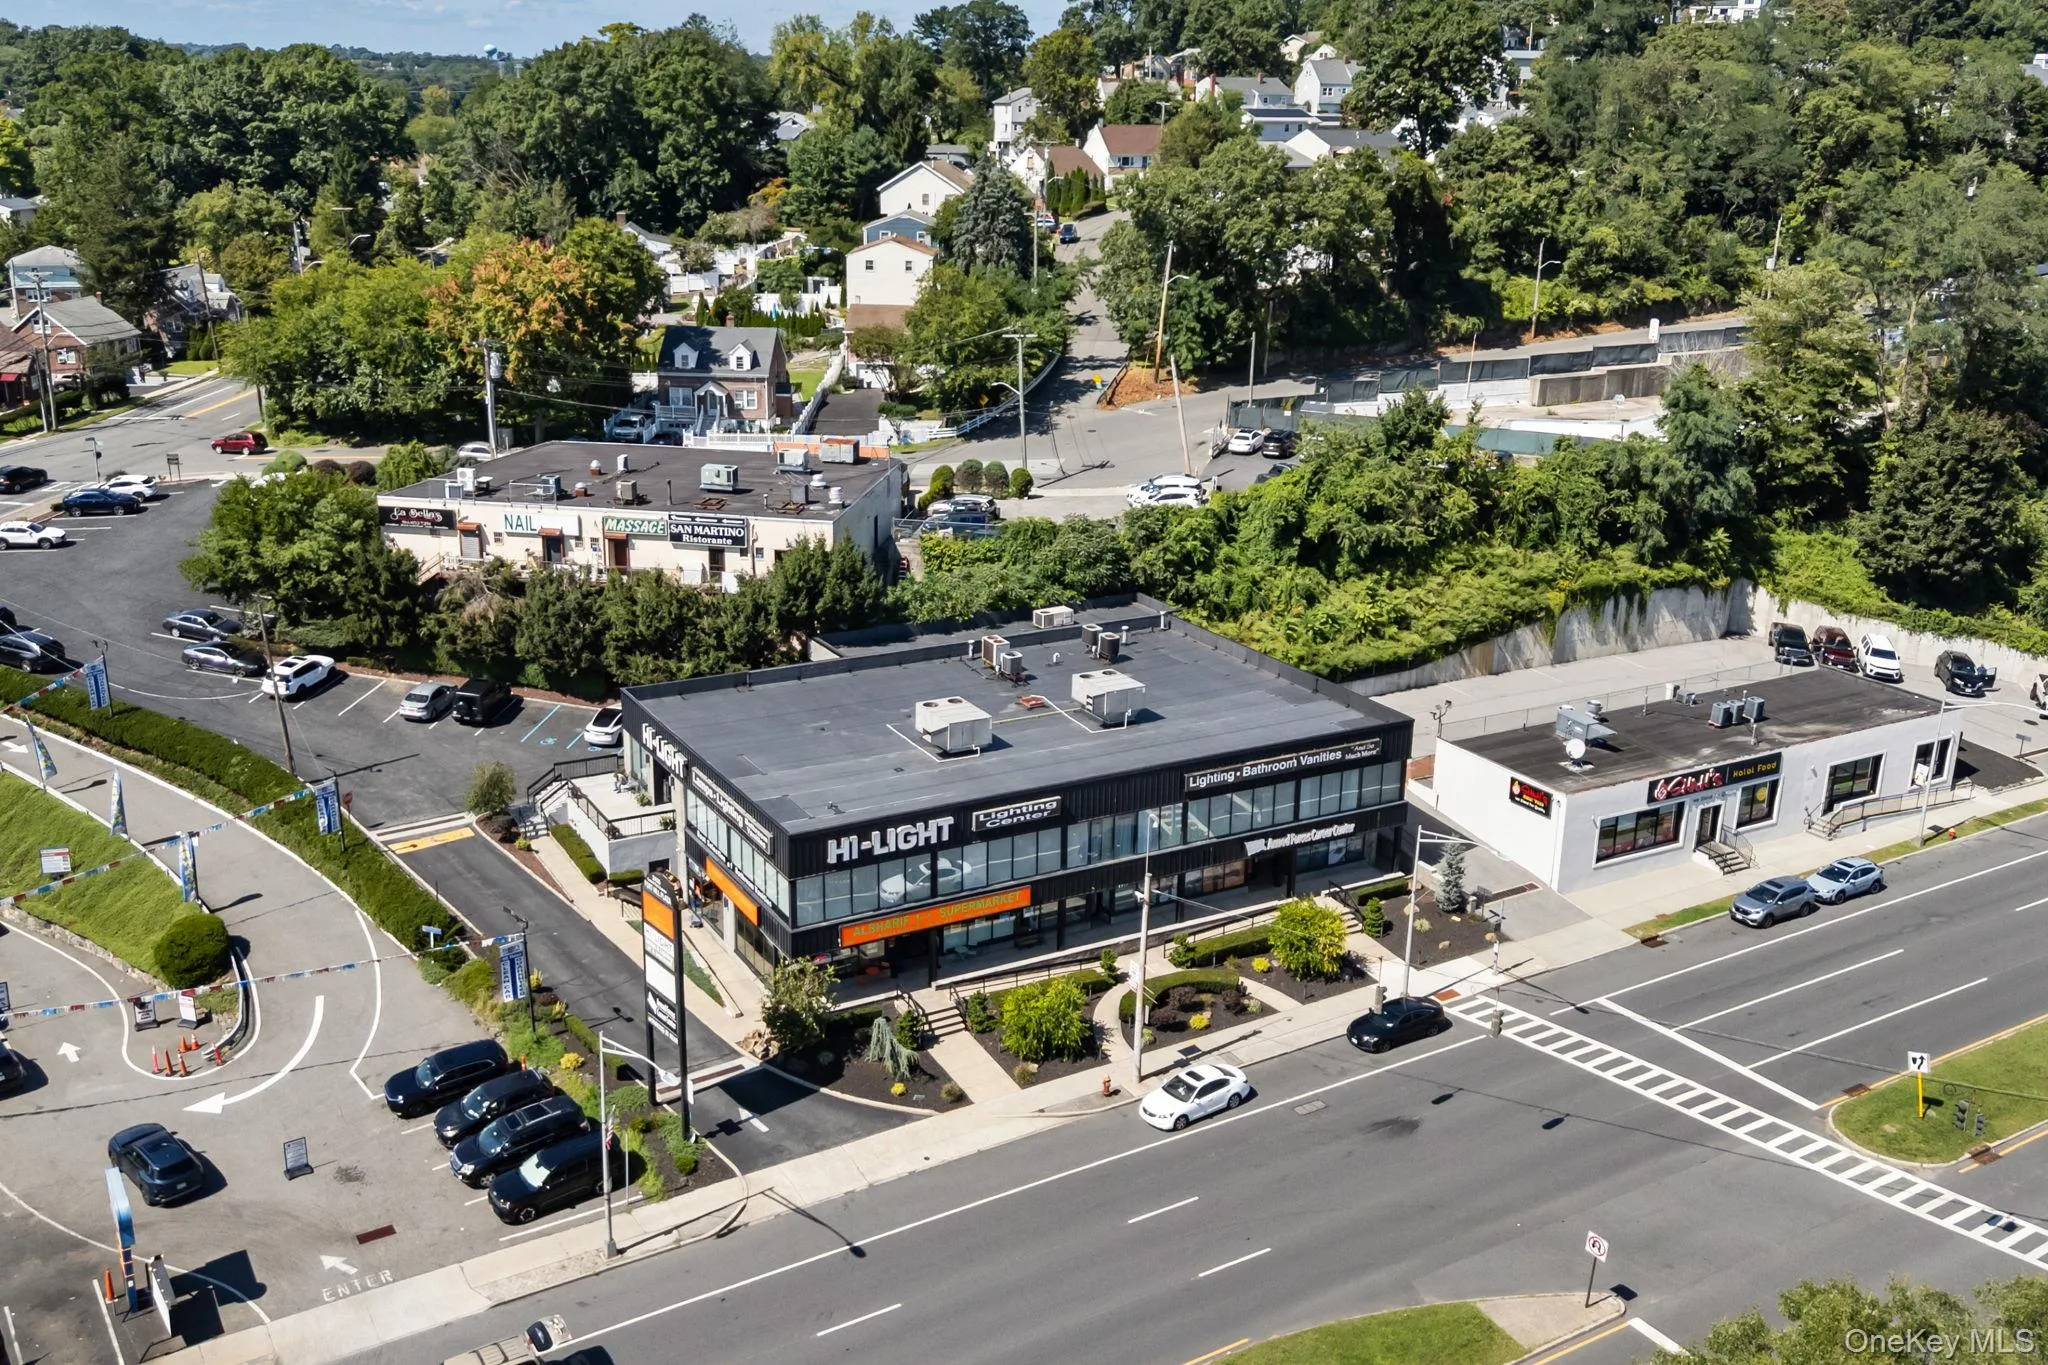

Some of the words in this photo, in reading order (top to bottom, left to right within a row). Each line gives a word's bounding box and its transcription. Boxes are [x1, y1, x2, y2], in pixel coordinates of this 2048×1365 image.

[504, 514, 538, 532] NAIL
[605, 518, 665, 534] MASSAGE
[670, 523, 692, 534] SAN
[694, 525, 744, 537] MARTINO
[682, 534, 733, 545] Ristorante
[642, 723, 688, 778] HI-LIGHT
[1189, 770, 1234, 787] Lighting
[1243, 759, 1297, 777] Bathroom
[1300, 751, 1342, 766] Vanities
[1758, 761, 1777, 772] Food
[979, 799, 1058, 822] Lighting
[985, 810, 1051, 828] Center
[826, 816, 954, 864] HI-LIGHT
[939, 892, 1022, 918] SUPERMARKET
[322, 1269, 393, 1302] ENTER
